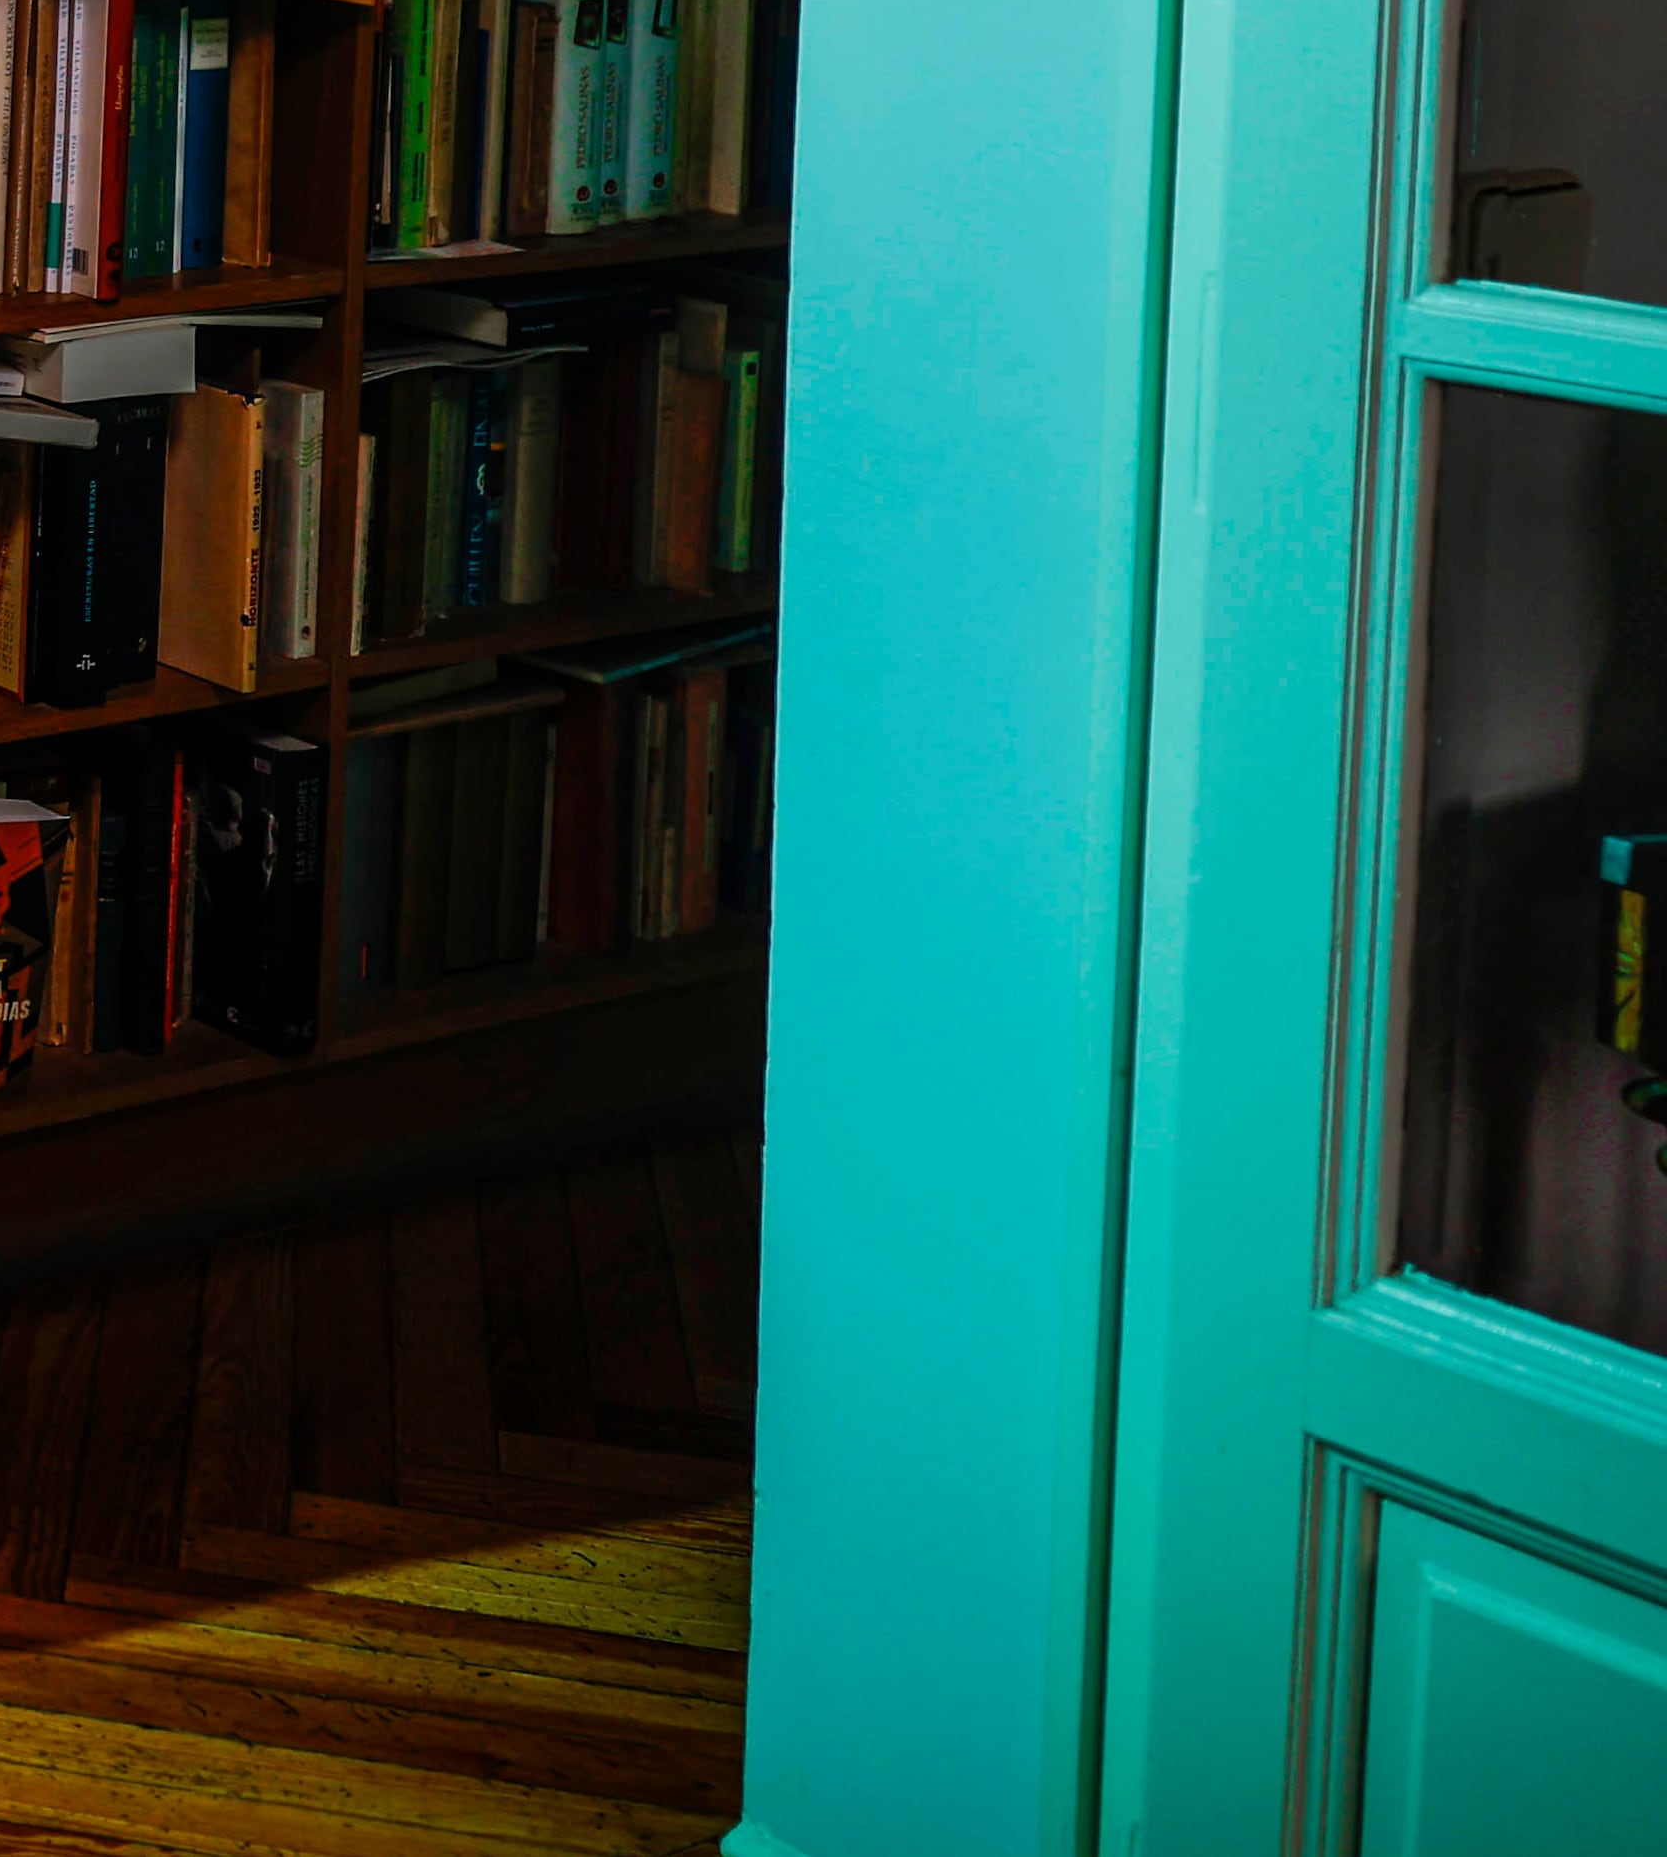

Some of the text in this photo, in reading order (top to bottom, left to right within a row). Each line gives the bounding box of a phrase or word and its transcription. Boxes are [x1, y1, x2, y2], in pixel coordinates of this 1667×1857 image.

[4, 61, 13, 78] LO
[87, 479, 97, 534] LIBERTAD
[84, 556, 94, 623] ESCRITURAS
[248, 547, 260, 627] HORIZONTE
